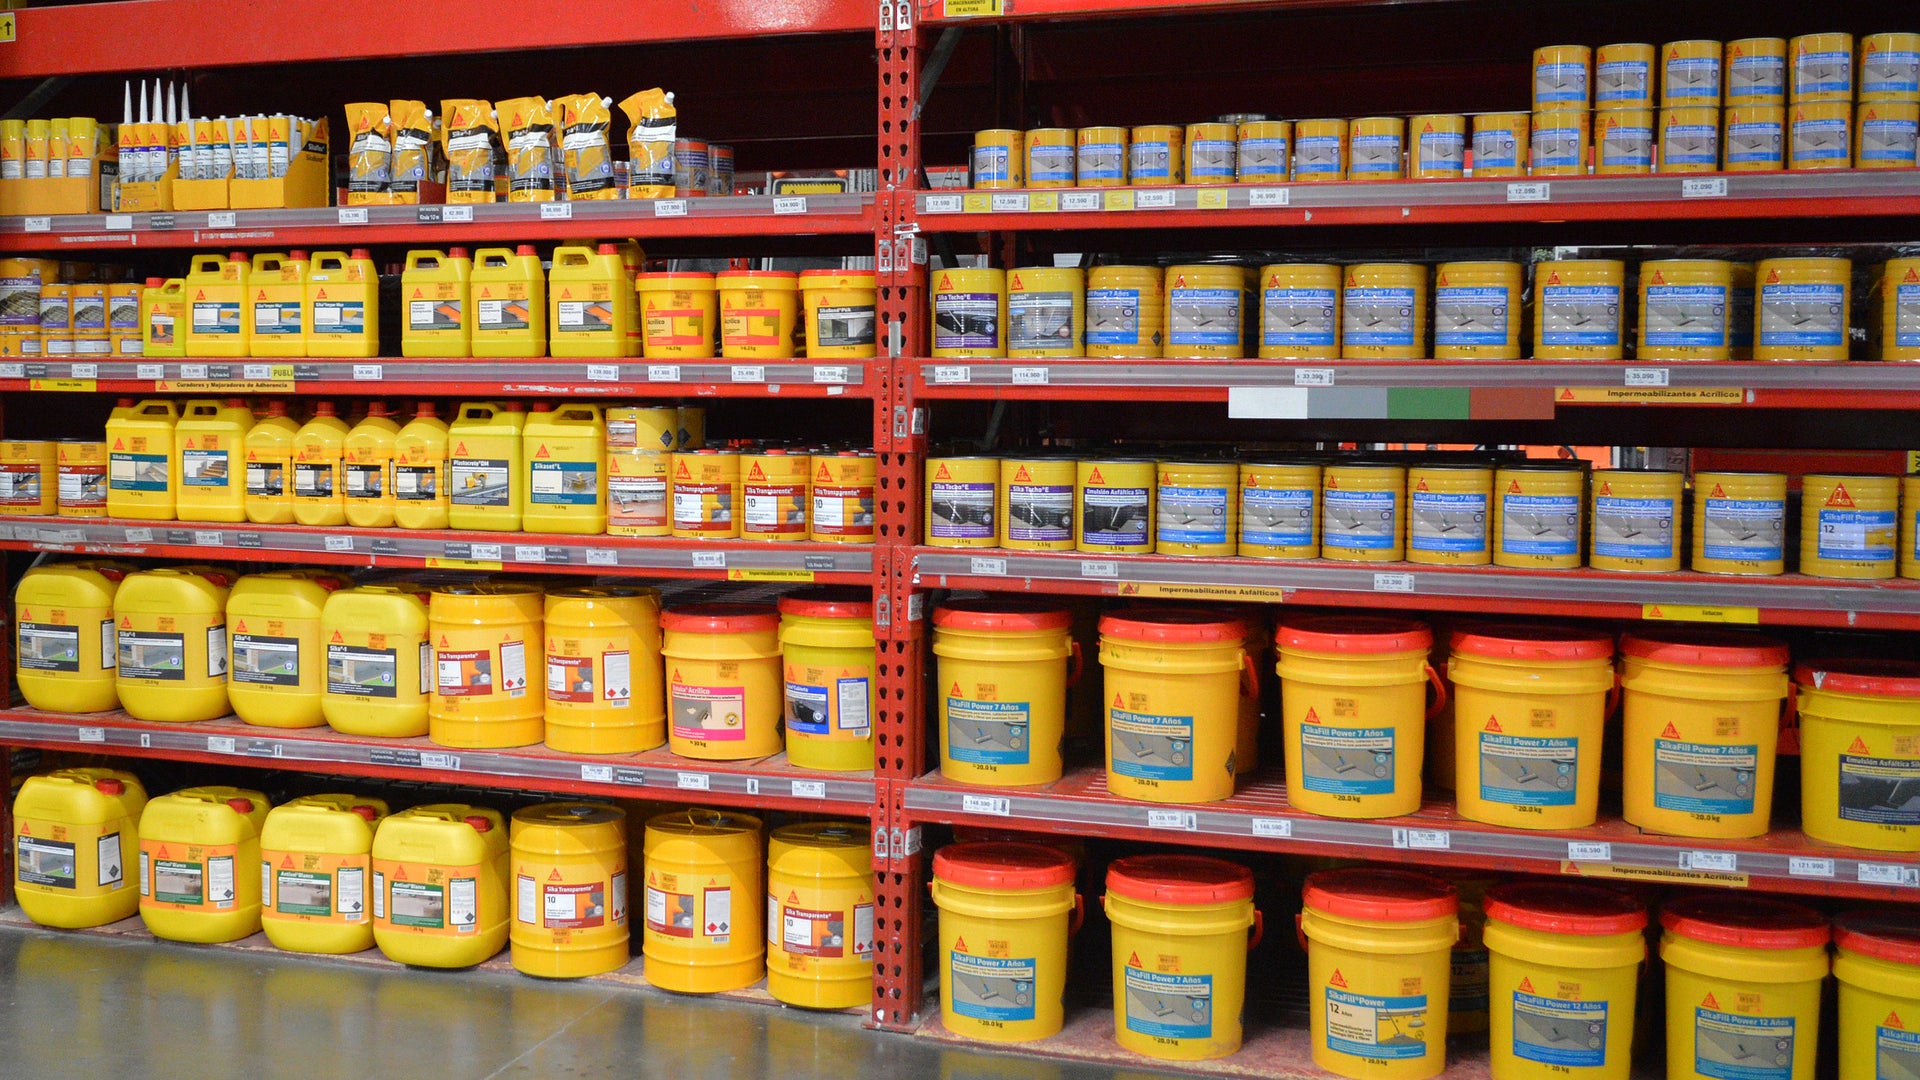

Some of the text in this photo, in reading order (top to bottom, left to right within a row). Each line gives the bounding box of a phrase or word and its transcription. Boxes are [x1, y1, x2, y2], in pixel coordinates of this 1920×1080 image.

[1608, 390, 1740, 398] Impermeabilizantes Acrílicos
[675, 496, 682, 505] 10
[747, 498, 756, 508] 10
[815, 499, 823, 509] 10
[1824, 513, 1879, 522] SikaFill Power
[1824, 525, 1835, 534] 12
[1159, 586, 1280, 597] Impermeabilizantes Asfálticos
[689, 686, 710, 695] Acrílico
[949, 700, 970, 710] SikaFill
[971, 702, 992, 711] Power
[994, 703, 1000, 711] 7
[1112, 711, 1132, 720] SikaFill
[1133, 715, 1154, 724] Power
[1304, 725, 1330, 736] SikaFill
[1331, 728, 1356, 737] Power
[1364, 728, 1384, 737] Años
[1483, 734, 1512, 745] SikaFill
[1514, 738, 1539, 747] Power
[1548, 738, 1568, 746] Años
[1659, 741, 1748, 754] SikaFill Power 7 Años
[1846, 756, 1878, 766] Emulsión
[1878, 759, 1910, 768] Asfáltica
[989, 764, 998, 773] kg
[1353, 795, 1361, 803] kg
[1534, 806, 1542, 814] kg
[1712, 814, 1720, 822] kg
[1612, 866, 1744, 882] Impermeabilizantes Acrílicos
[547, 896, 556, 904] 10
[786, 918, 794, 927] 10
[953, 952, 976, 965] SikaFill
[977, 958, 998, 967] Power
[1006, 960, 1026, 968] Años
[1128, 968, 1201, 984] SikaFill Power 7 Años
[1359, 998, 1385, 1007] Power
[1517, 993, 1544, 1005] SikaFill
[1546, 999, 1570, 1009] Power
[1329, 1002, 1339, 1014] 12
[1700, 1010, 1730, 1024] SikaFill
[1731, 1015, 1758, 1026] Power
[1760, 1018, 1768, 1026] 12
[996, 1020, 1003, 1028] kg
[1882, 1028, 1915, 1041] SikaFill
[1157, 1037, 1179, 1046] 20.0 kg
[1561, 1066, 1570, 1074] kg
